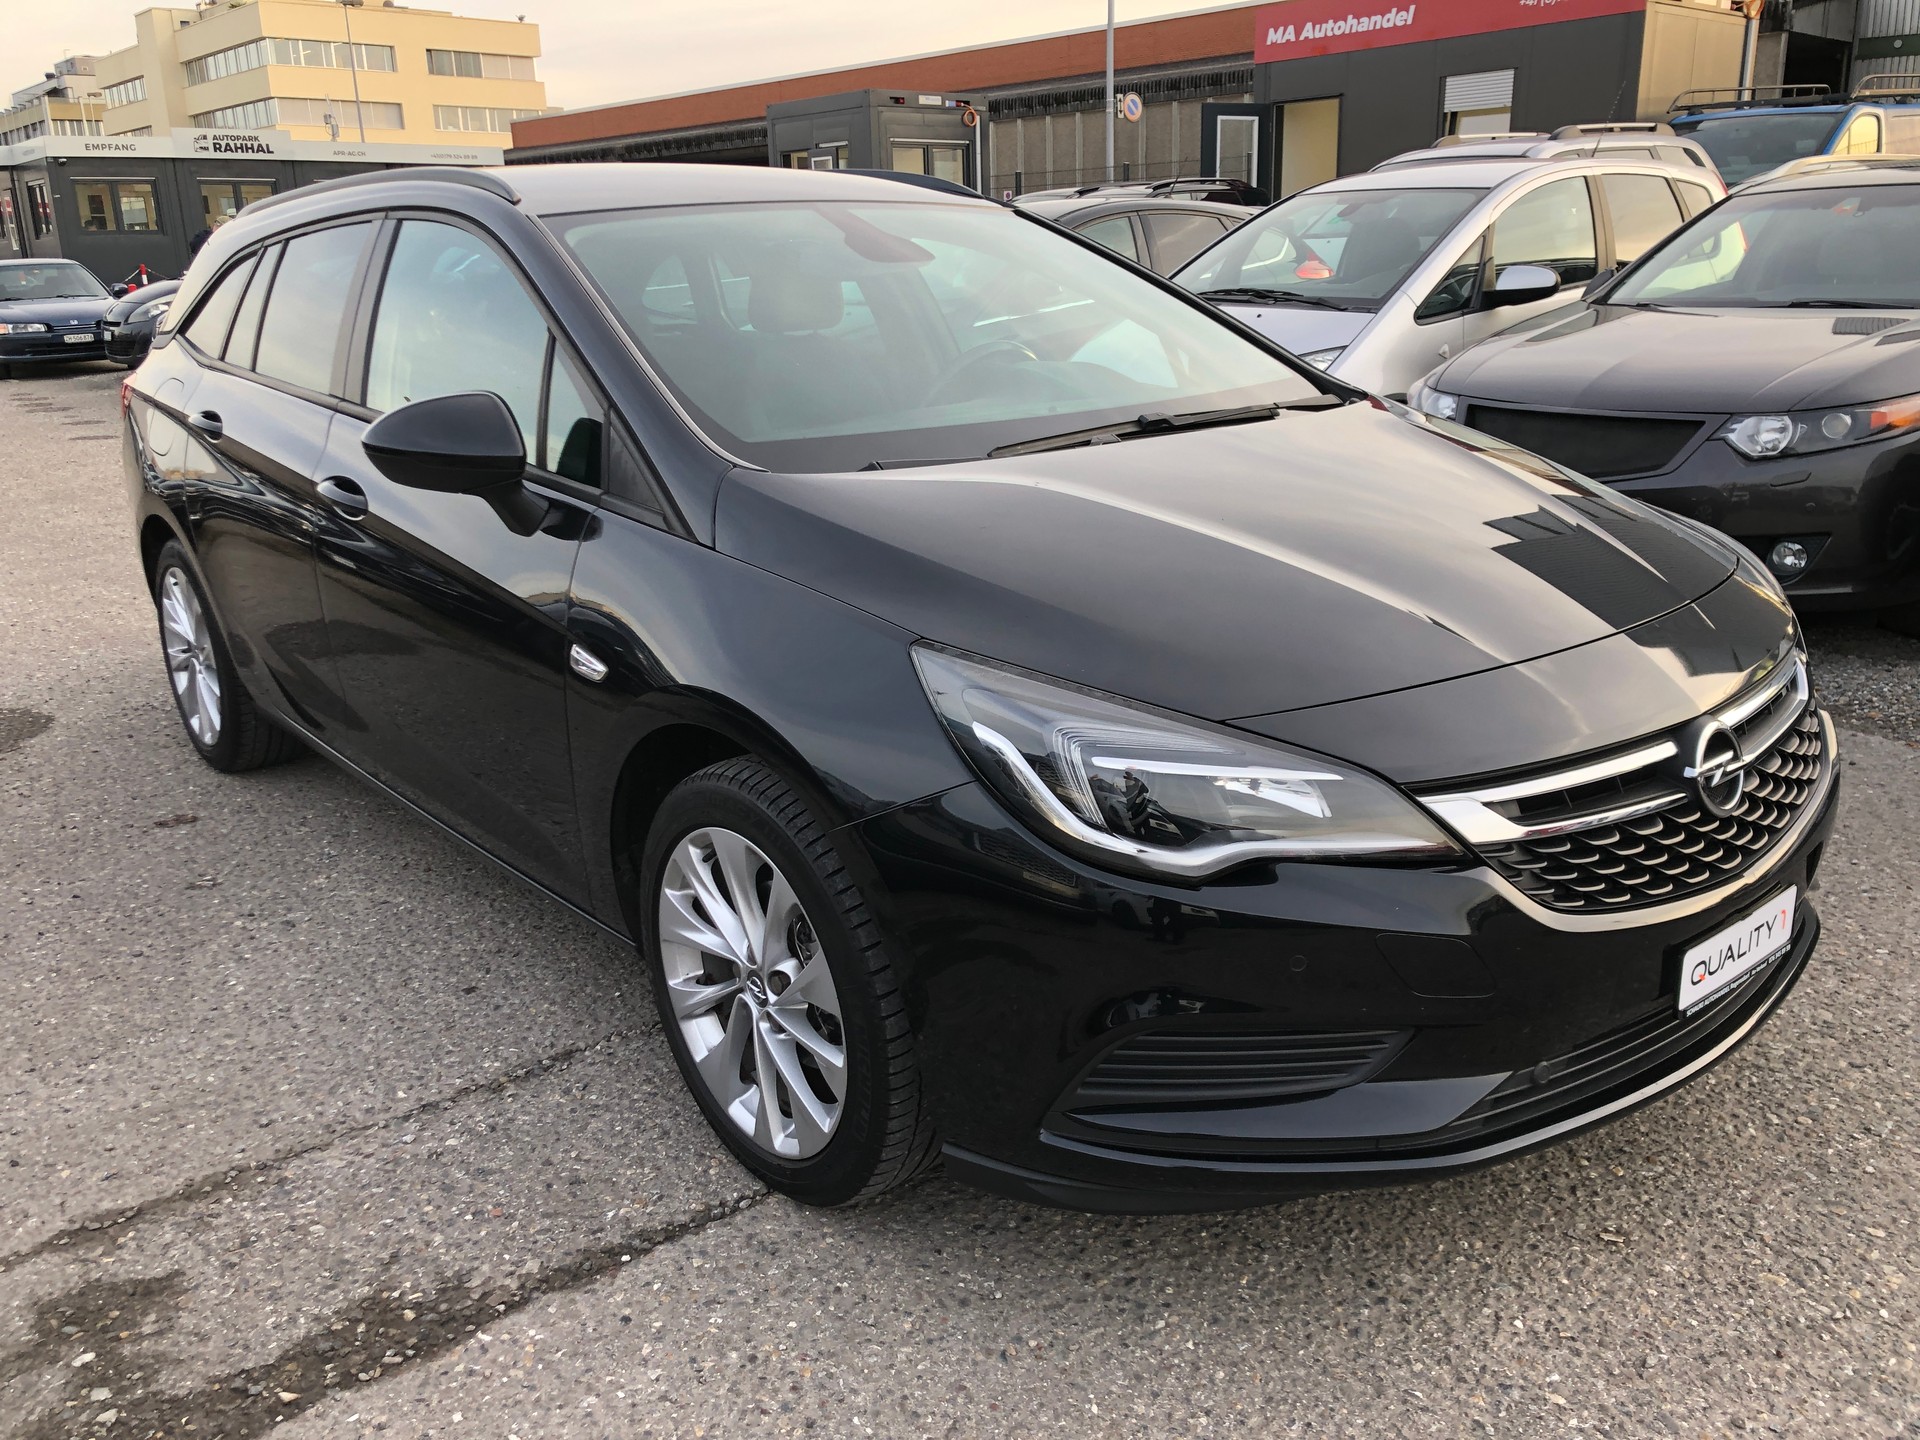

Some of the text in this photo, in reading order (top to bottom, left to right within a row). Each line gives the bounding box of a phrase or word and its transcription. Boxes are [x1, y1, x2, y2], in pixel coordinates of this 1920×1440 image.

[1266, 5, 1416, 46] MA Autohandel
[212, 134, 260, 142] AUTOPARK
[84, 143, 137, 151] EMPFANG
[212, 142, 275, 154] RAHHAL
